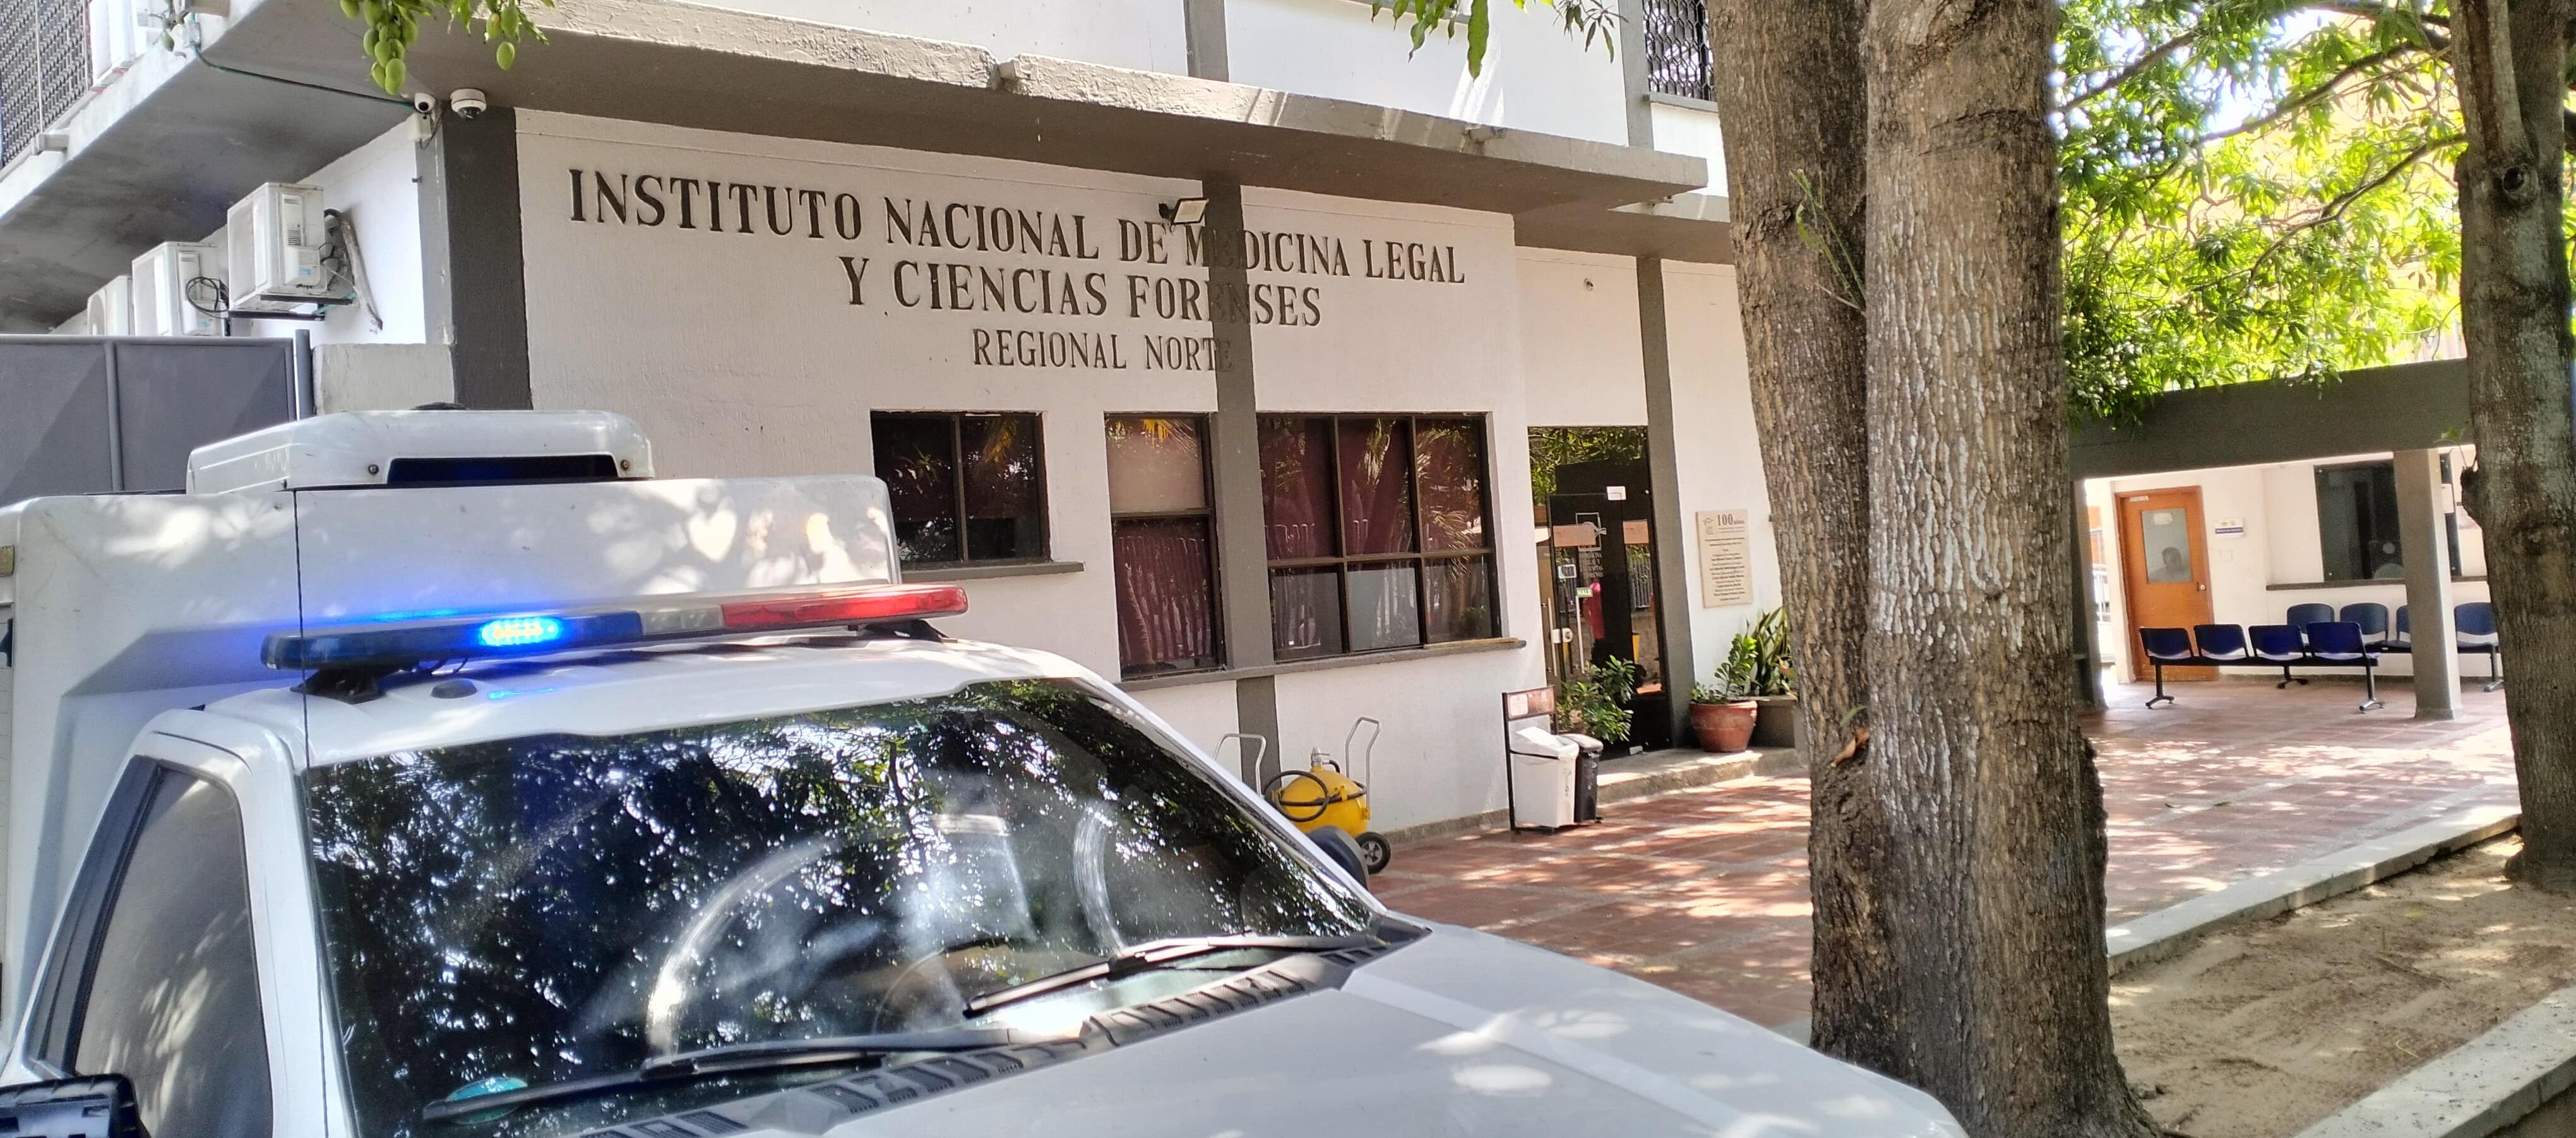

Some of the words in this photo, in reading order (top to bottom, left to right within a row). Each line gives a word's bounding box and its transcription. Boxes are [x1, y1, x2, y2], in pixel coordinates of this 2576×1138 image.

[568, 169, 862, 241] INSTITUTO
[884, 196, 1099, 260] NACIONAL
[1118, 219, 1168, 265] DE
[1183, 224, 1351, 277] MEDICINA
[1364, 239, 1466, 284] LEGAL
[839, 256, 870, 306] Y
[893, 260, 1107, 316] CIENCIAS
[1128, 275, 1323, 327] FORENSES
[972, 328, 1127, 370] REGIONAL
[1144, 334, 1232, 371] NORTE
[1717, 513, 1733, 526] 100
